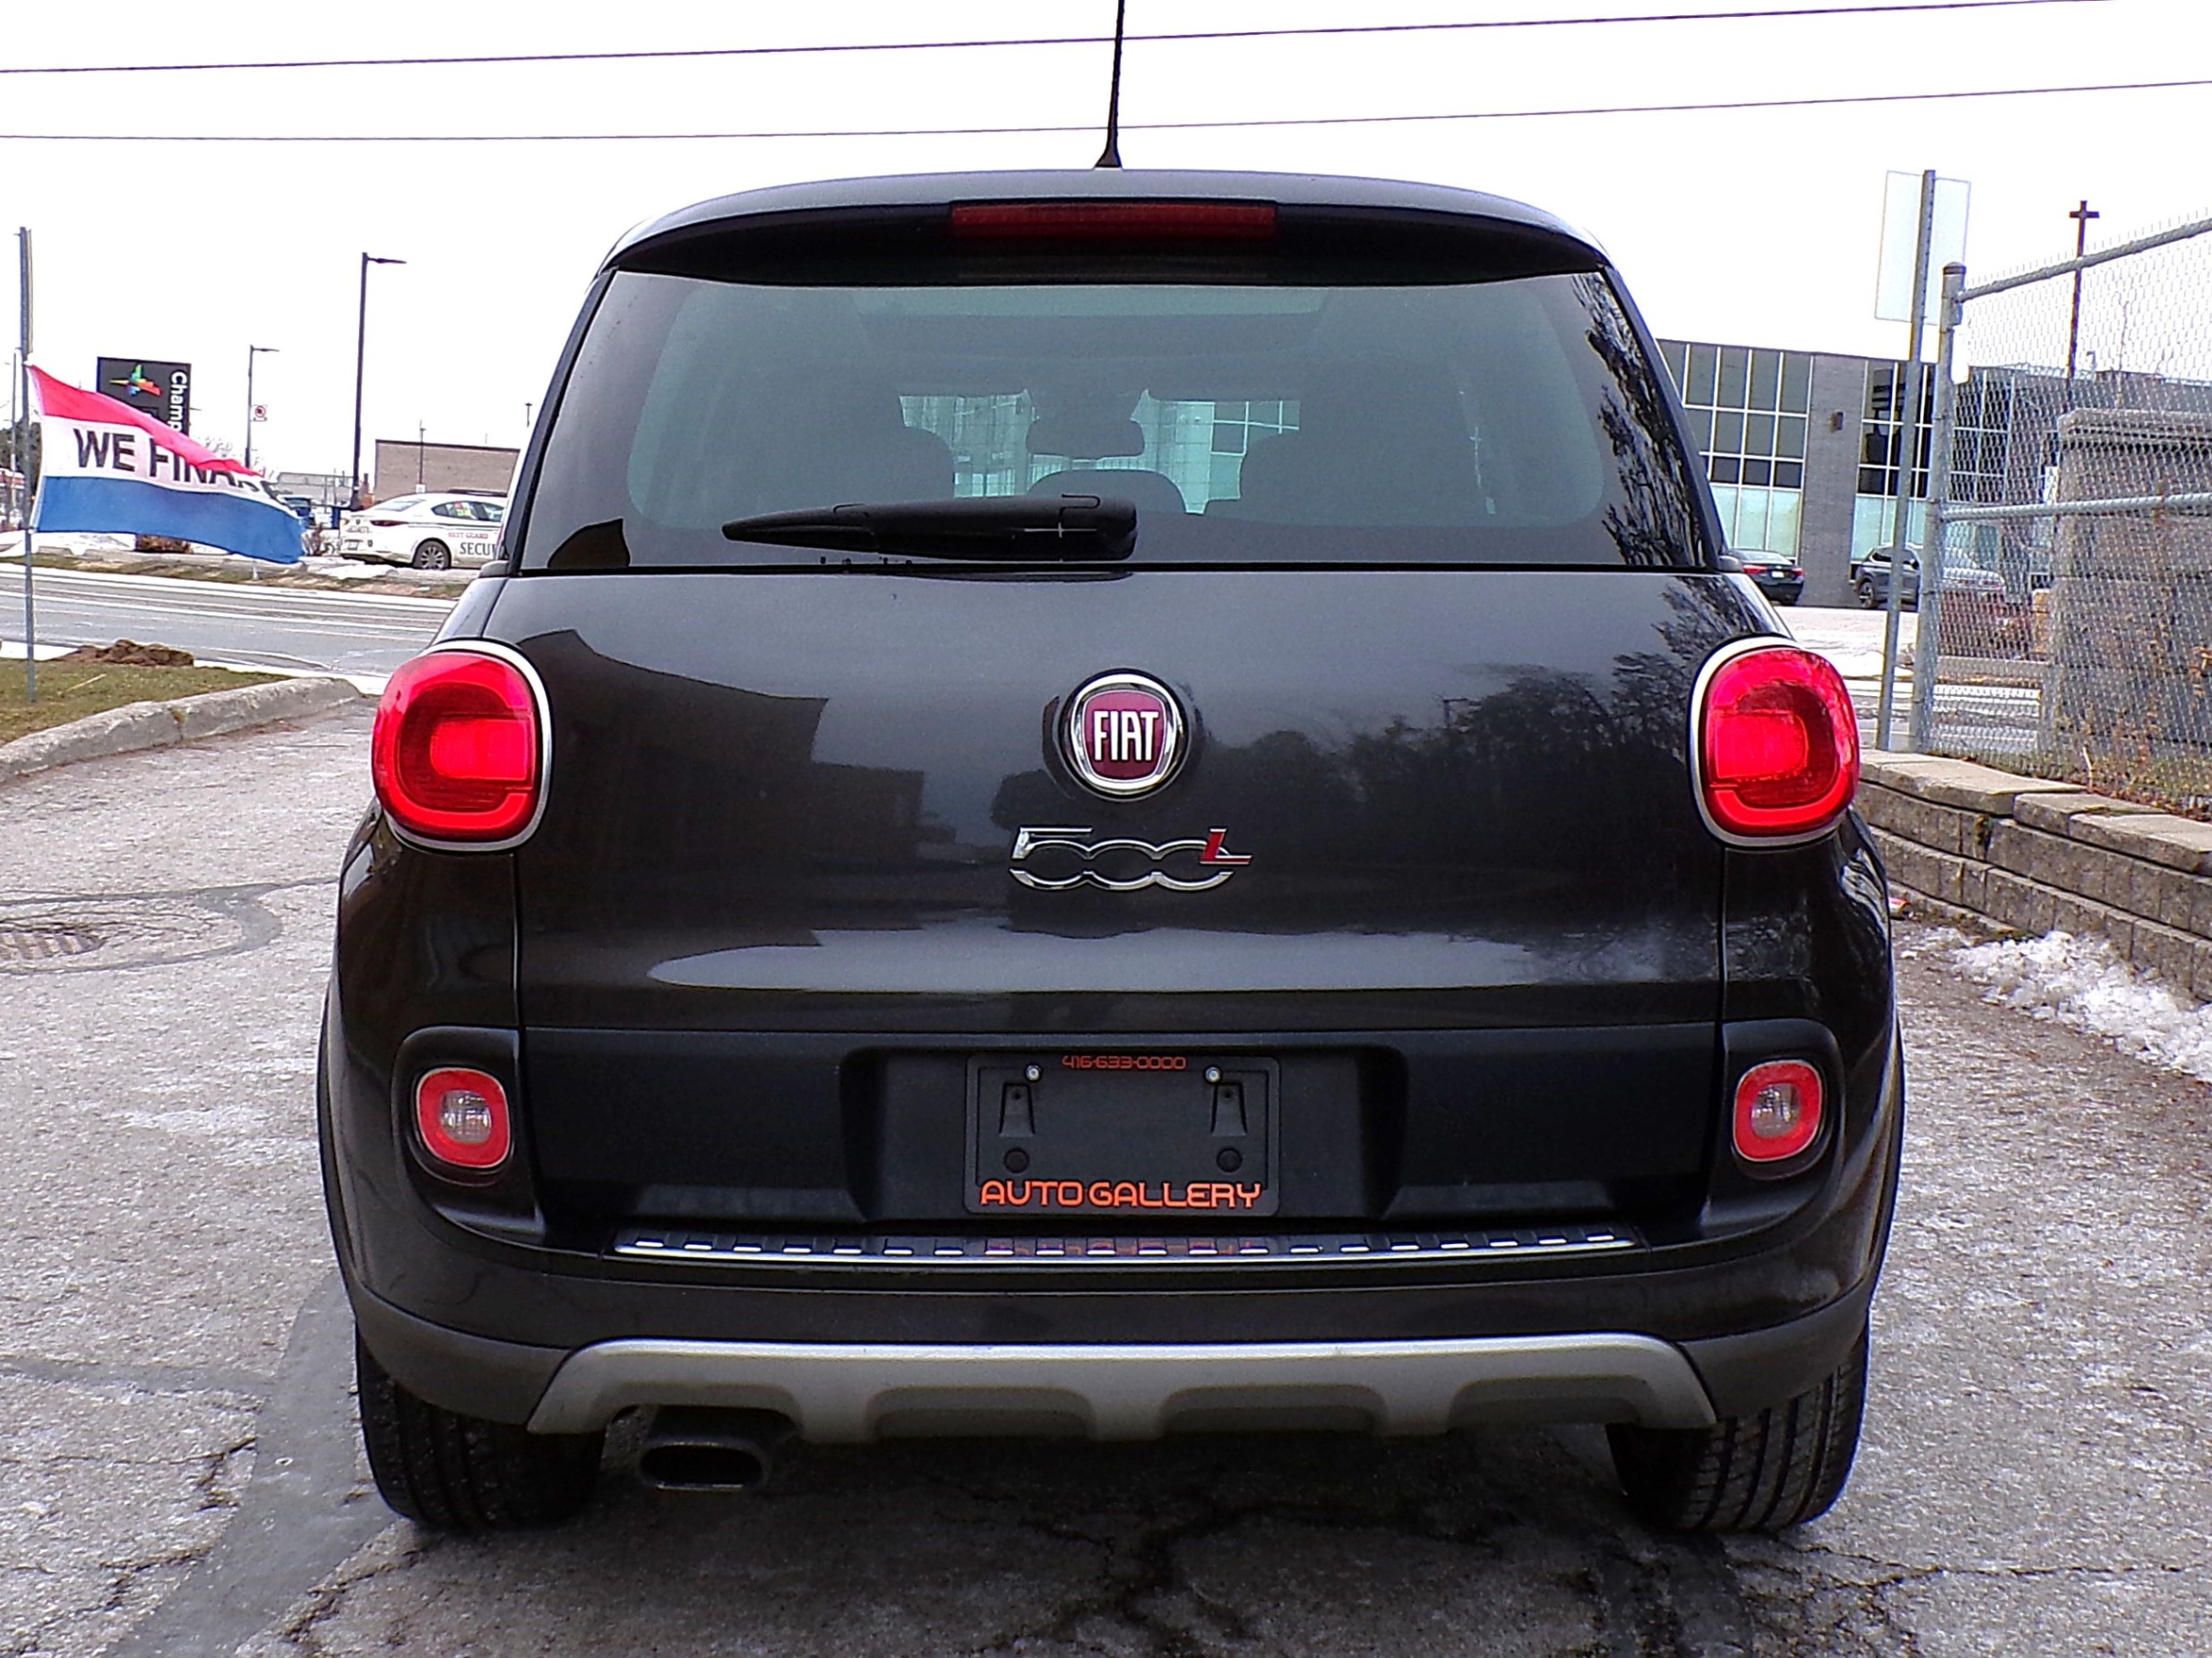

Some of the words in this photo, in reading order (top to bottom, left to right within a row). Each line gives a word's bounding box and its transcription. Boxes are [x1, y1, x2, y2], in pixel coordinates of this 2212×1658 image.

[73, 428, 134, 471] WE
[149, 438, 278, 496] FINA
[1092, 710, 1159, 760] FIAT
[1009, 827, 1253, 891] 500L
[1062, 1055, 1186, 1070] 416-633-0000
[980, 1180, 1084, 1206] AUTO
[1088, 1181, 1261, 1208] GALLERY
